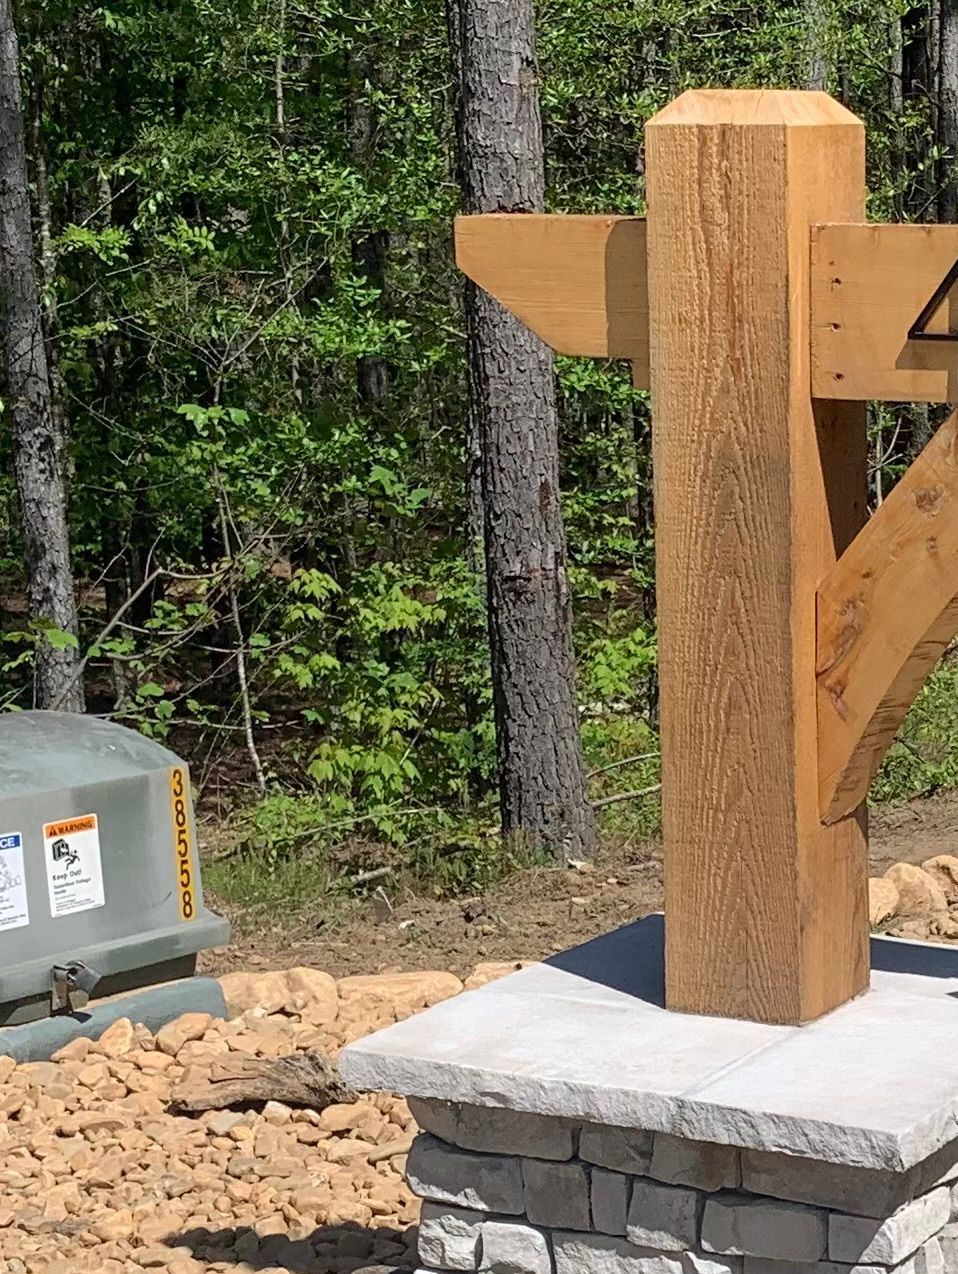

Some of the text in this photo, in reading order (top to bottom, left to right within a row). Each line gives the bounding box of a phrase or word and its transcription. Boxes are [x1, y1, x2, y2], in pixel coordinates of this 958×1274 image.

[57, 819, 94, 834] WARNING
[173, 769, 192, 918] 38558
[52, 873, 67, 881] Keep
